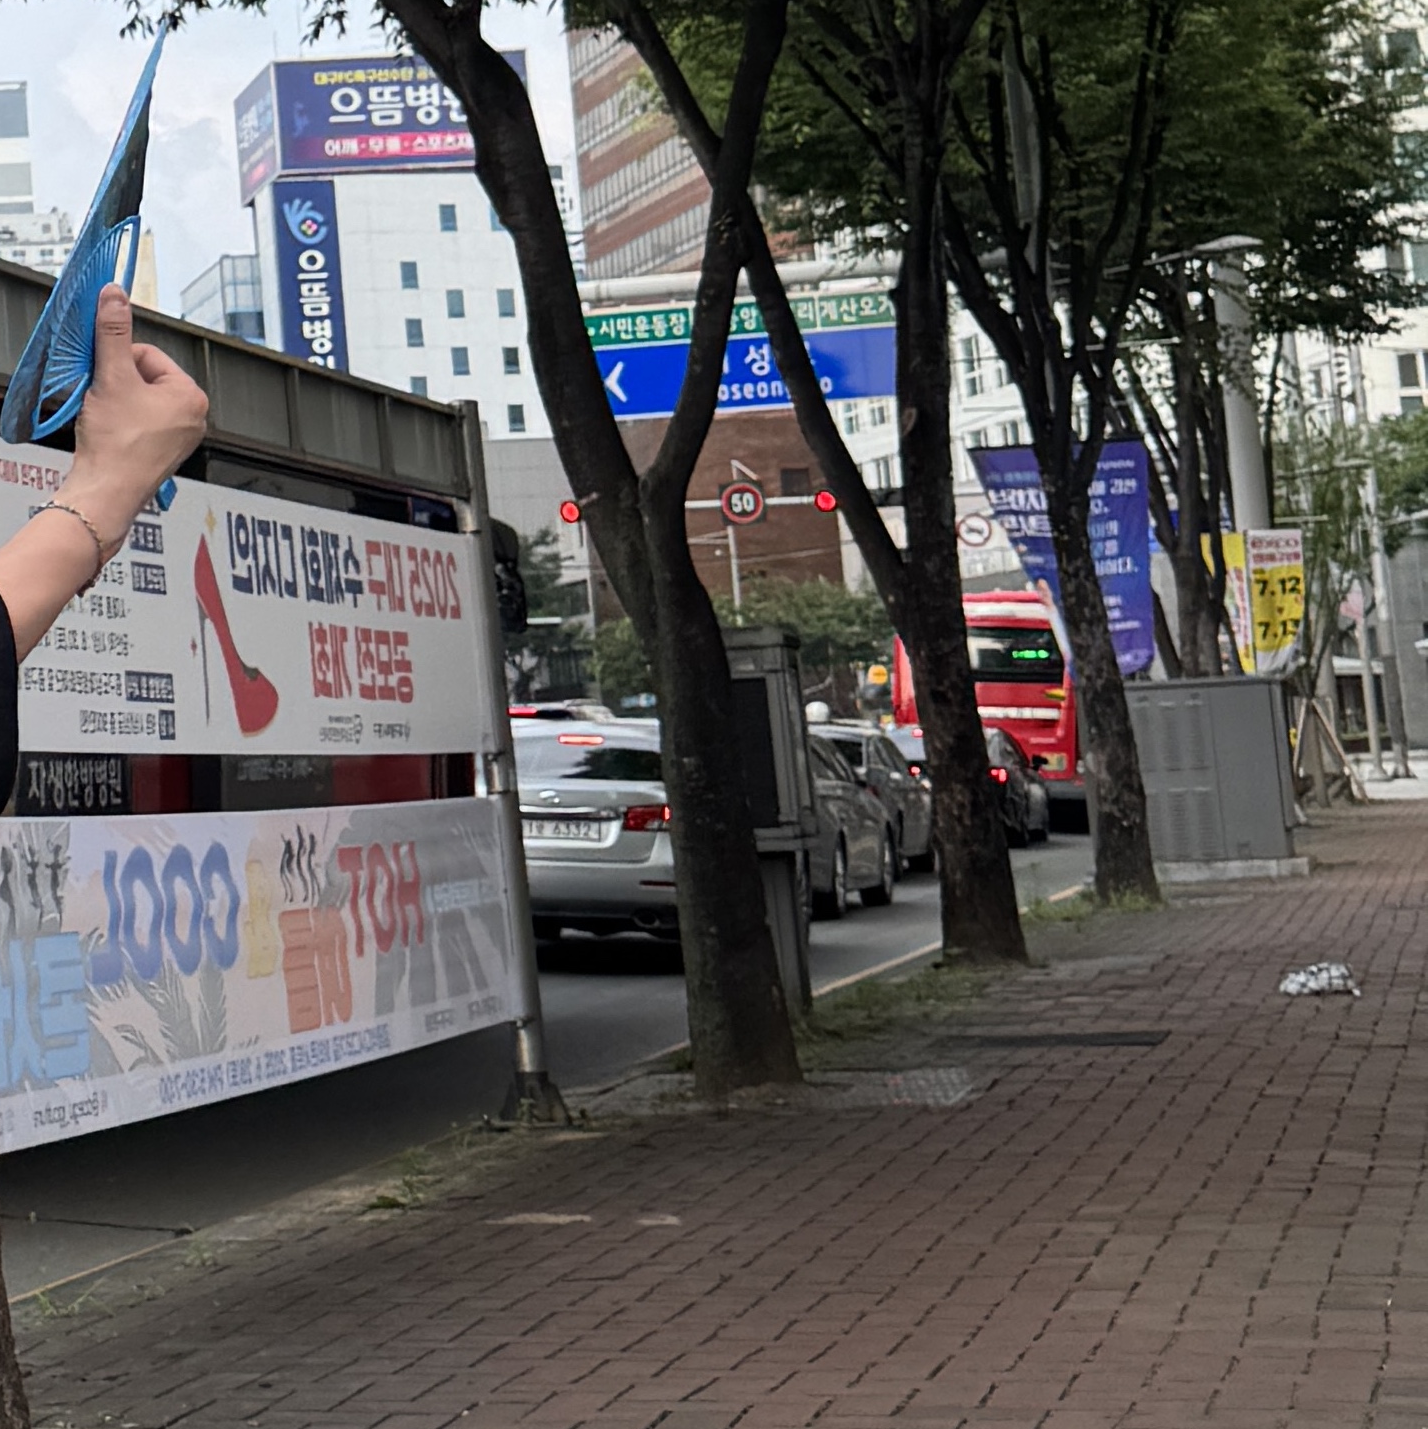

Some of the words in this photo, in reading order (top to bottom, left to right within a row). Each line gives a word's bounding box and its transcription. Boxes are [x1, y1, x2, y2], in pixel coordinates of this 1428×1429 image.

[819, 294, 895, 322] 계산오거
[599, 313, 687, 340] 시민운동장
[731, 492, 754, 512] 50
[1254, 576, 1302, 597] 7.12
[26, 758, 123, 809] 자생한방병원
